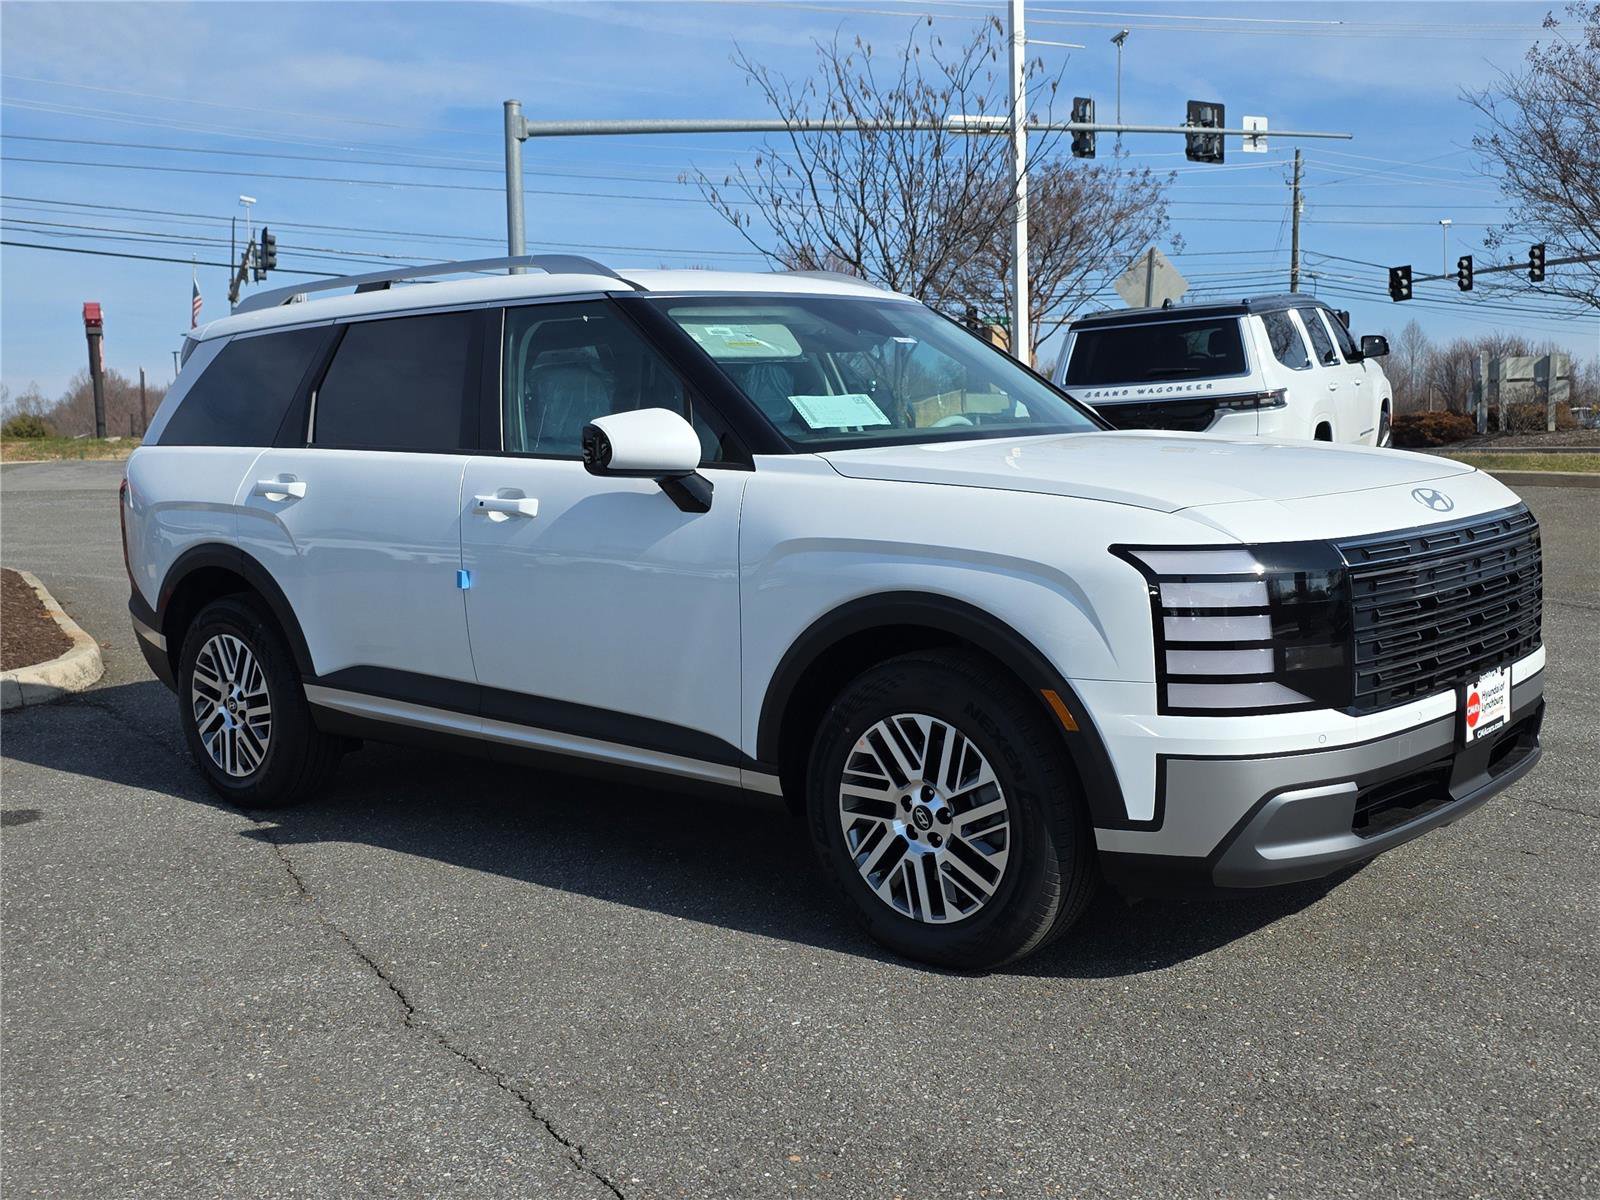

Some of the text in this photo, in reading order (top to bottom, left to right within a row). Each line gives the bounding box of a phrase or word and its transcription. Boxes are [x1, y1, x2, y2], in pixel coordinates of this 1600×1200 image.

[1084, 383, 1214, 399] GRAND WAGONEER
[1482, 683, 1500, 701] Hyundai
[962, 700, 1027, 783] NEXEN
